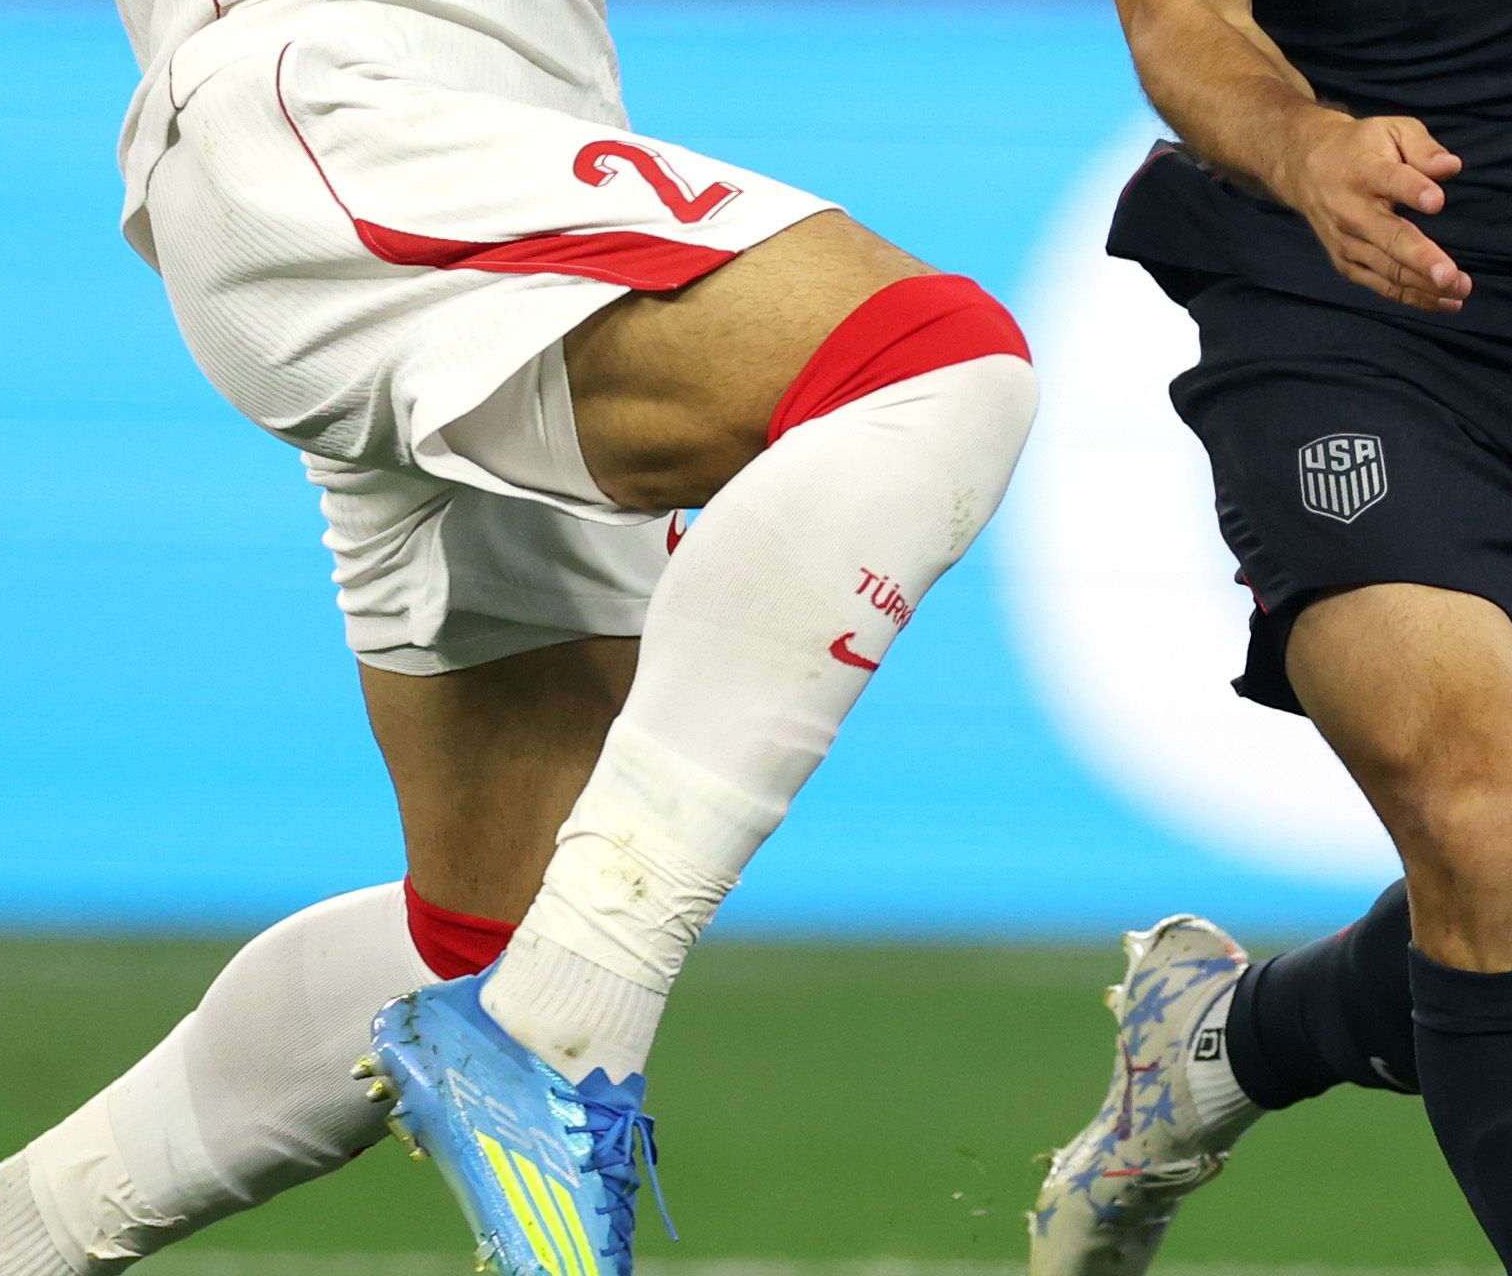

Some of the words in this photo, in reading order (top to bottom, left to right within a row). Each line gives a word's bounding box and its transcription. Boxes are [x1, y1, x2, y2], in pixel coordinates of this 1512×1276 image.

[573, 140, 743, 224] 2
[1304, 439, 1376, 472] USA
[855, 566, 916, 632] TÜRK
